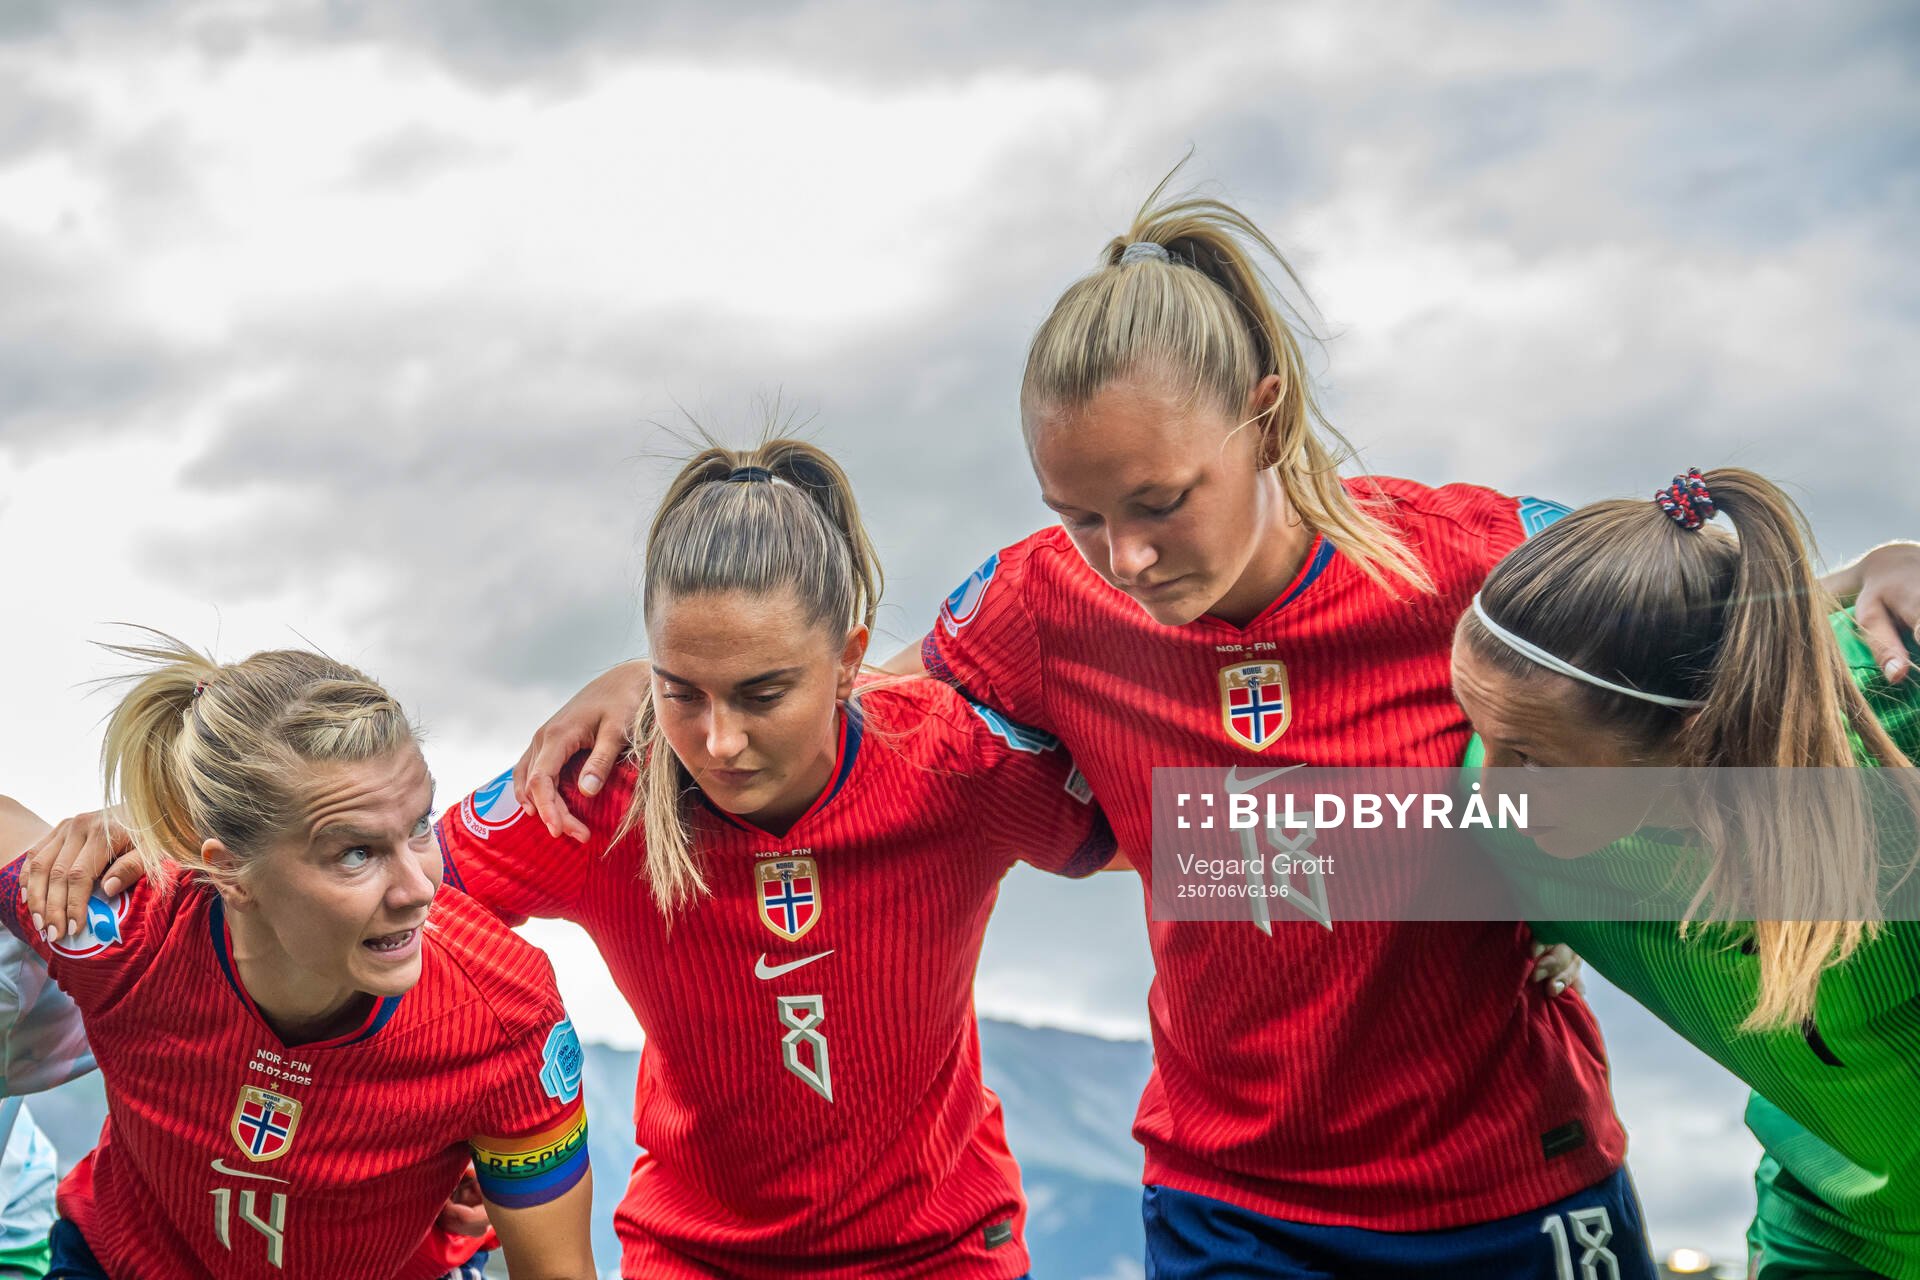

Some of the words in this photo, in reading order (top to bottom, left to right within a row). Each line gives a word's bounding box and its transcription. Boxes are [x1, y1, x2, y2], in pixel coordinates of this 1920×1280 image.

[1216, 644, 1243, 652] NOR
[1254, 642, 1276, 651] FIN
[471, 822, 487, 835] 2025
[791, 848, 811, 856] FIN
[1229, 810, 1334, 937] 18
[256, 1049, 281, 1064] NOR
[290, 1060, 312, 1073] FIN
[777, 994, 833, 1103] 8
[248, 1060, 312, 1086] 06.07.2025
[489, 1123, 584, 1174] RESPECT
[208, 1188, 287, 1269] 14
[1540, 1206, 1620, 1280] 18
